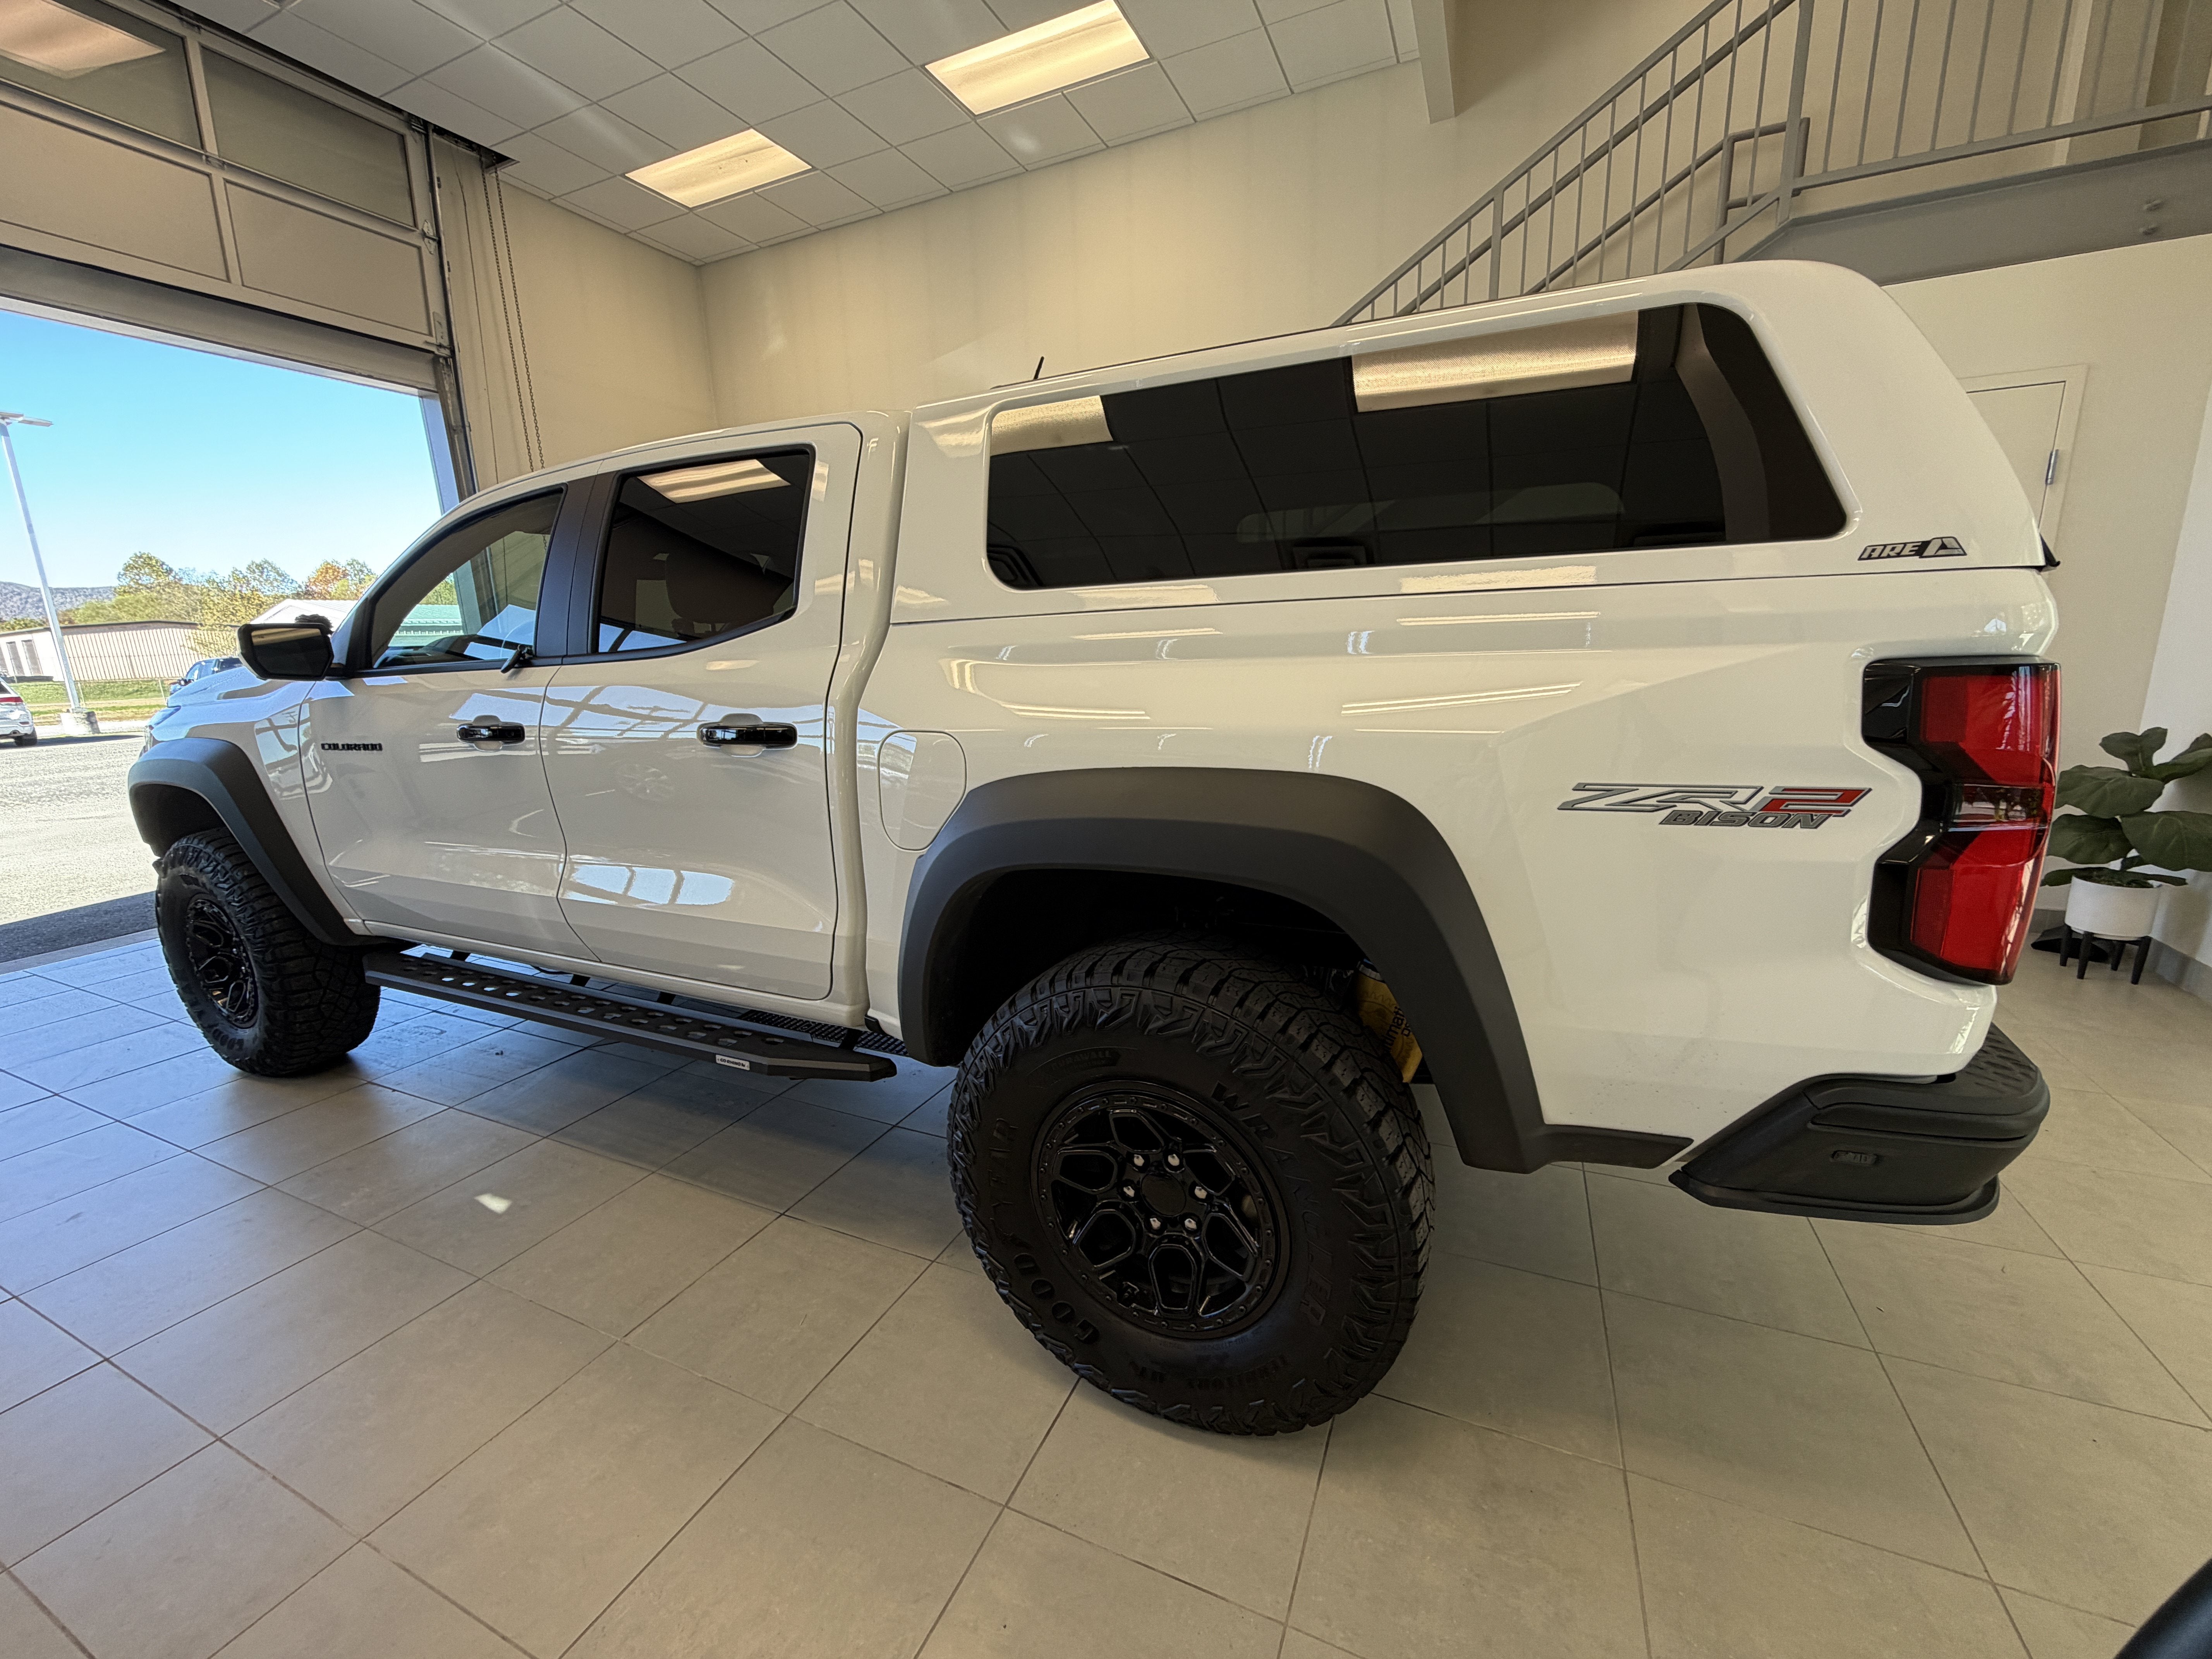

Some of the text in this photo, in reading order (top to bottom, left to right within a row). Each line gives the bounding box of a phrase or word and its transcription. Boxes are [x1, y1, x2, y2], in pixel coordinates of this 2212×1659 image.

[1861, 542, 1922, 559] ARE
[321, 743, 383, 751] COLORADO
[1557, 782, 1872, 817] ZR2
[1659, 810, 1833, 829] BISON
[988, 1118, 1100, 1345] GOODYEAR
